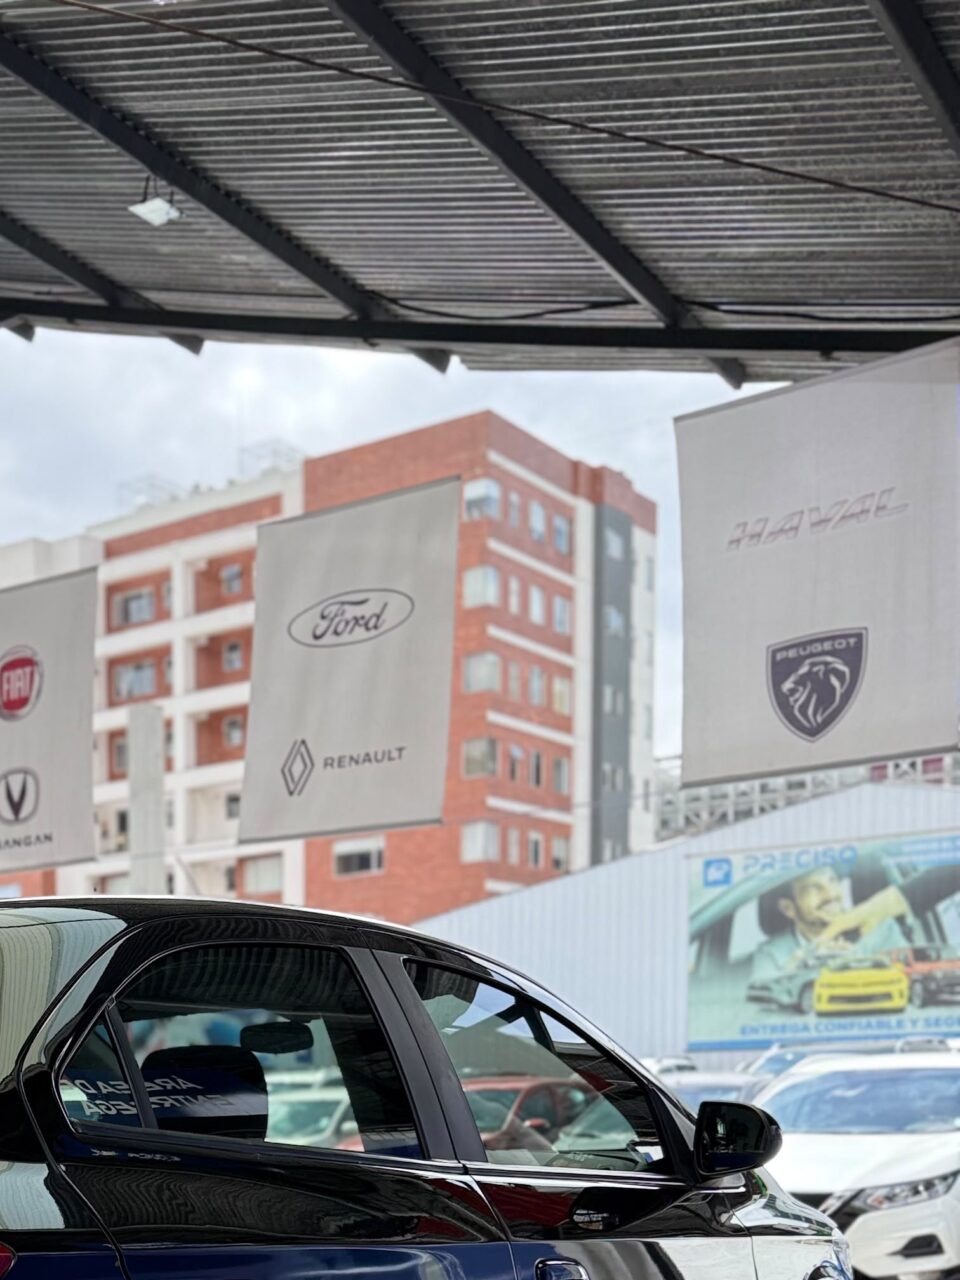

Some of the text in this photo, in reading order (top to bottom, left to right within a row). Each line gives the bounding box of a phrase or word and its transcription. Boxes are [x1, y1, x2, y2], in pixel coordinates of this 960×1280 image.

[727, 487, 910, 552] HAVAL
[311, 597, 389, 641] Ford
[775, 637, 858, 662] PEUGEOT
[2, 665, 34, 703] FIAT
[323, 746, 407, 770] RENAULT
[742, 845, 858, 871] PRECISO
